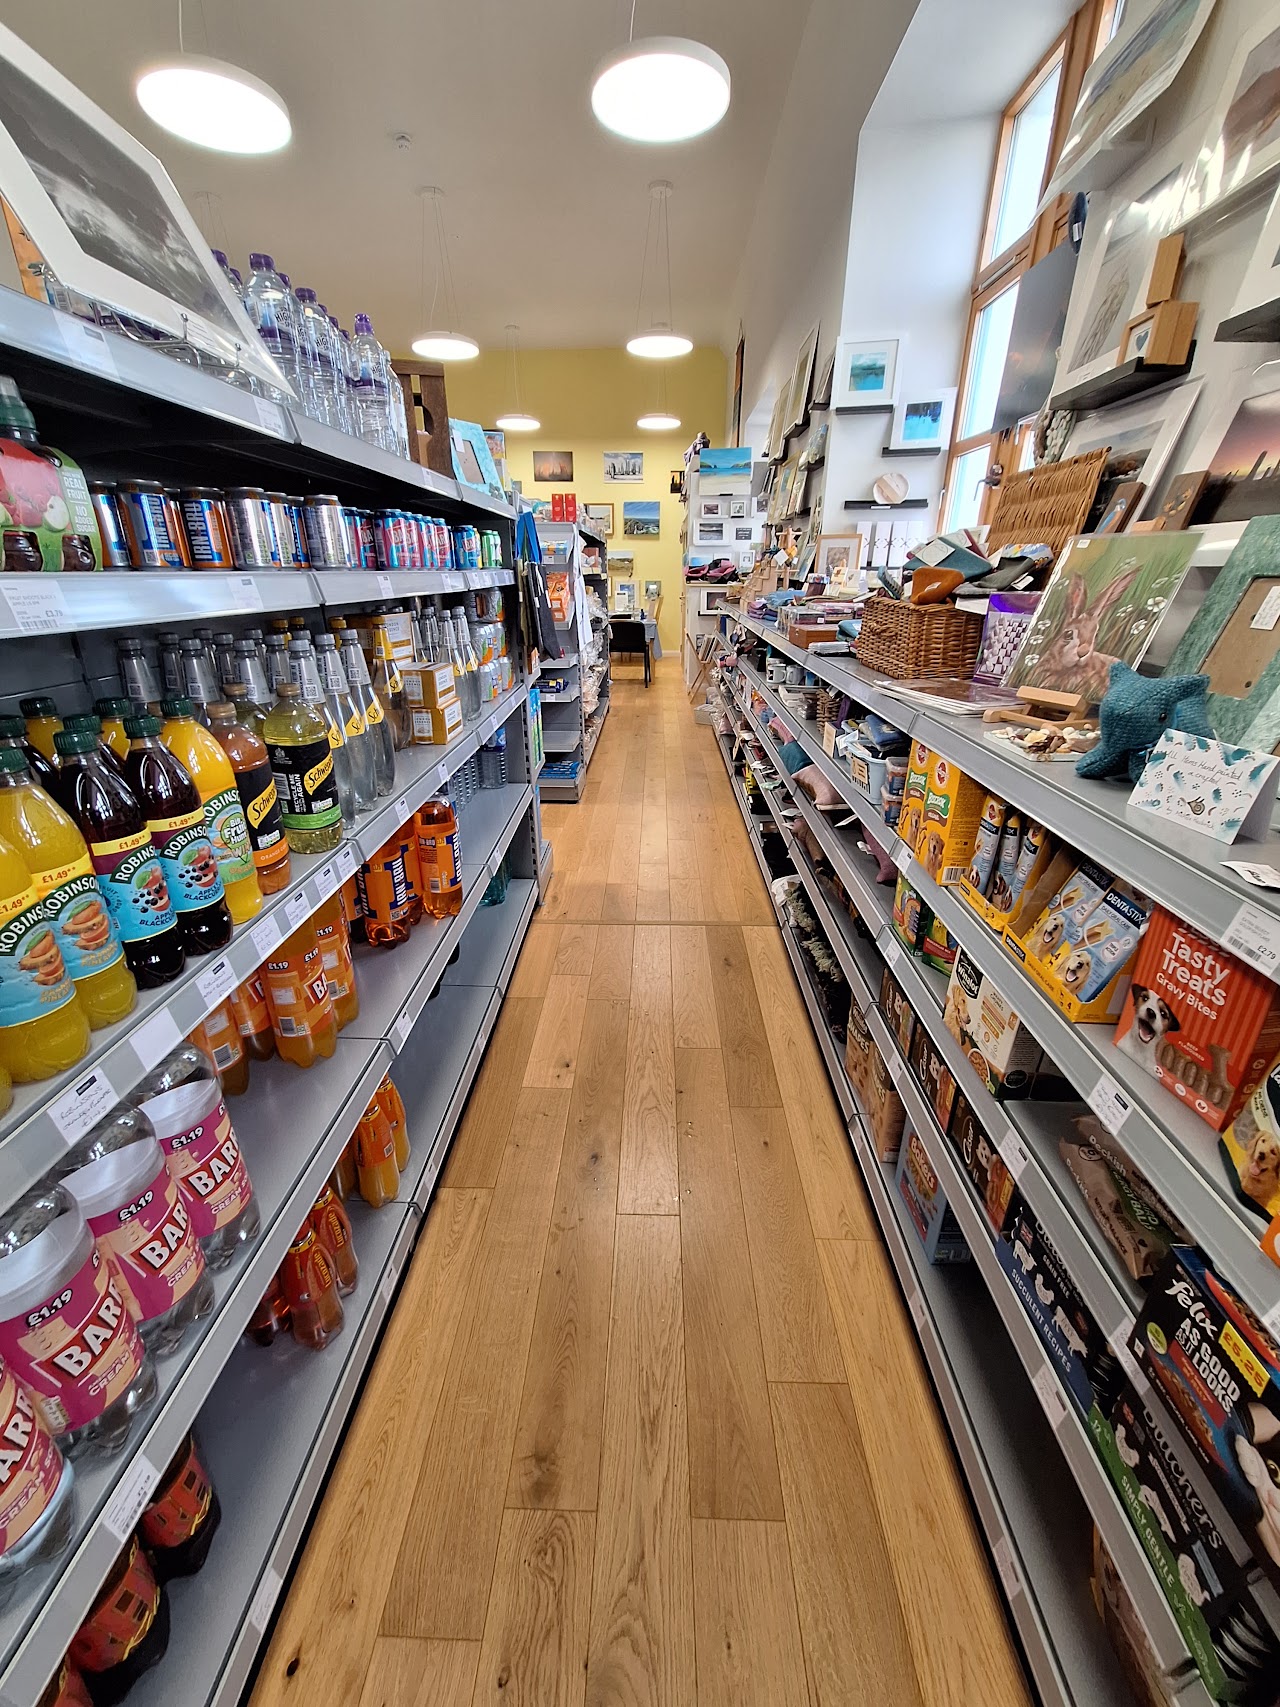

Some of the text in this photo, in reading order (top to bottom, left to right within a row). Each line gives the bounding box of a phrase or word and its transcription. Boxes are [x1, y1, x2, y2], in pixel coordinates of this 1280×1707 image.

[64, 476, 84, 491] REAL
[67, 488, 87, 501] FRUIT
[75, 506, 88, 517] NO
[75, 515, 94, 526] ADDED
[76, 524, 96, 533] SUGAR
[1101, 905, 1132, 931] DAILY ORAL CARE
[1106, 891, 1146, 925] DENTASTIX
[1172, 931, 1230, 985] Tasty
[1257, 944, 1277, 960] £2.79
[957, 964, 980, 995] Winalot
[1163, 948, 1227, 1007] Treats
[1156, 972, 1218, 1020] Gravy Bites
[1177, 1040, 1205, 1062] FLAVOURED
[172, 1127, 204, 1149] £1.19
[118, 1190, 155, 1222] £1.19
[211, 1187, 242, 1215] CREAM
[167, 1252, 197, 1287] CREAM
[1056, 1278, 1071, 1300] FREE
[26, 1288, 73, 1328] £1.19
[1010, 1268, 1073, 1374] SUCCULENT RECIPES
[1164, 1279, 1218, 1341] felix
[1175, 1328, 1187, 1346] AS
[88, 1349, 131, 1397] CREAM
[1180, 1317, 1201, 1347] AS
[1199, 1342, 1241, 1402] GOOD
[1222, 1331, 1266, 1389] £5.25
[0, 1387, 34, 1484] ARR
[1121, 1475, 1147, 1525] SIMPLY
[1145, 1526, 1175, 1588] GENTLE
